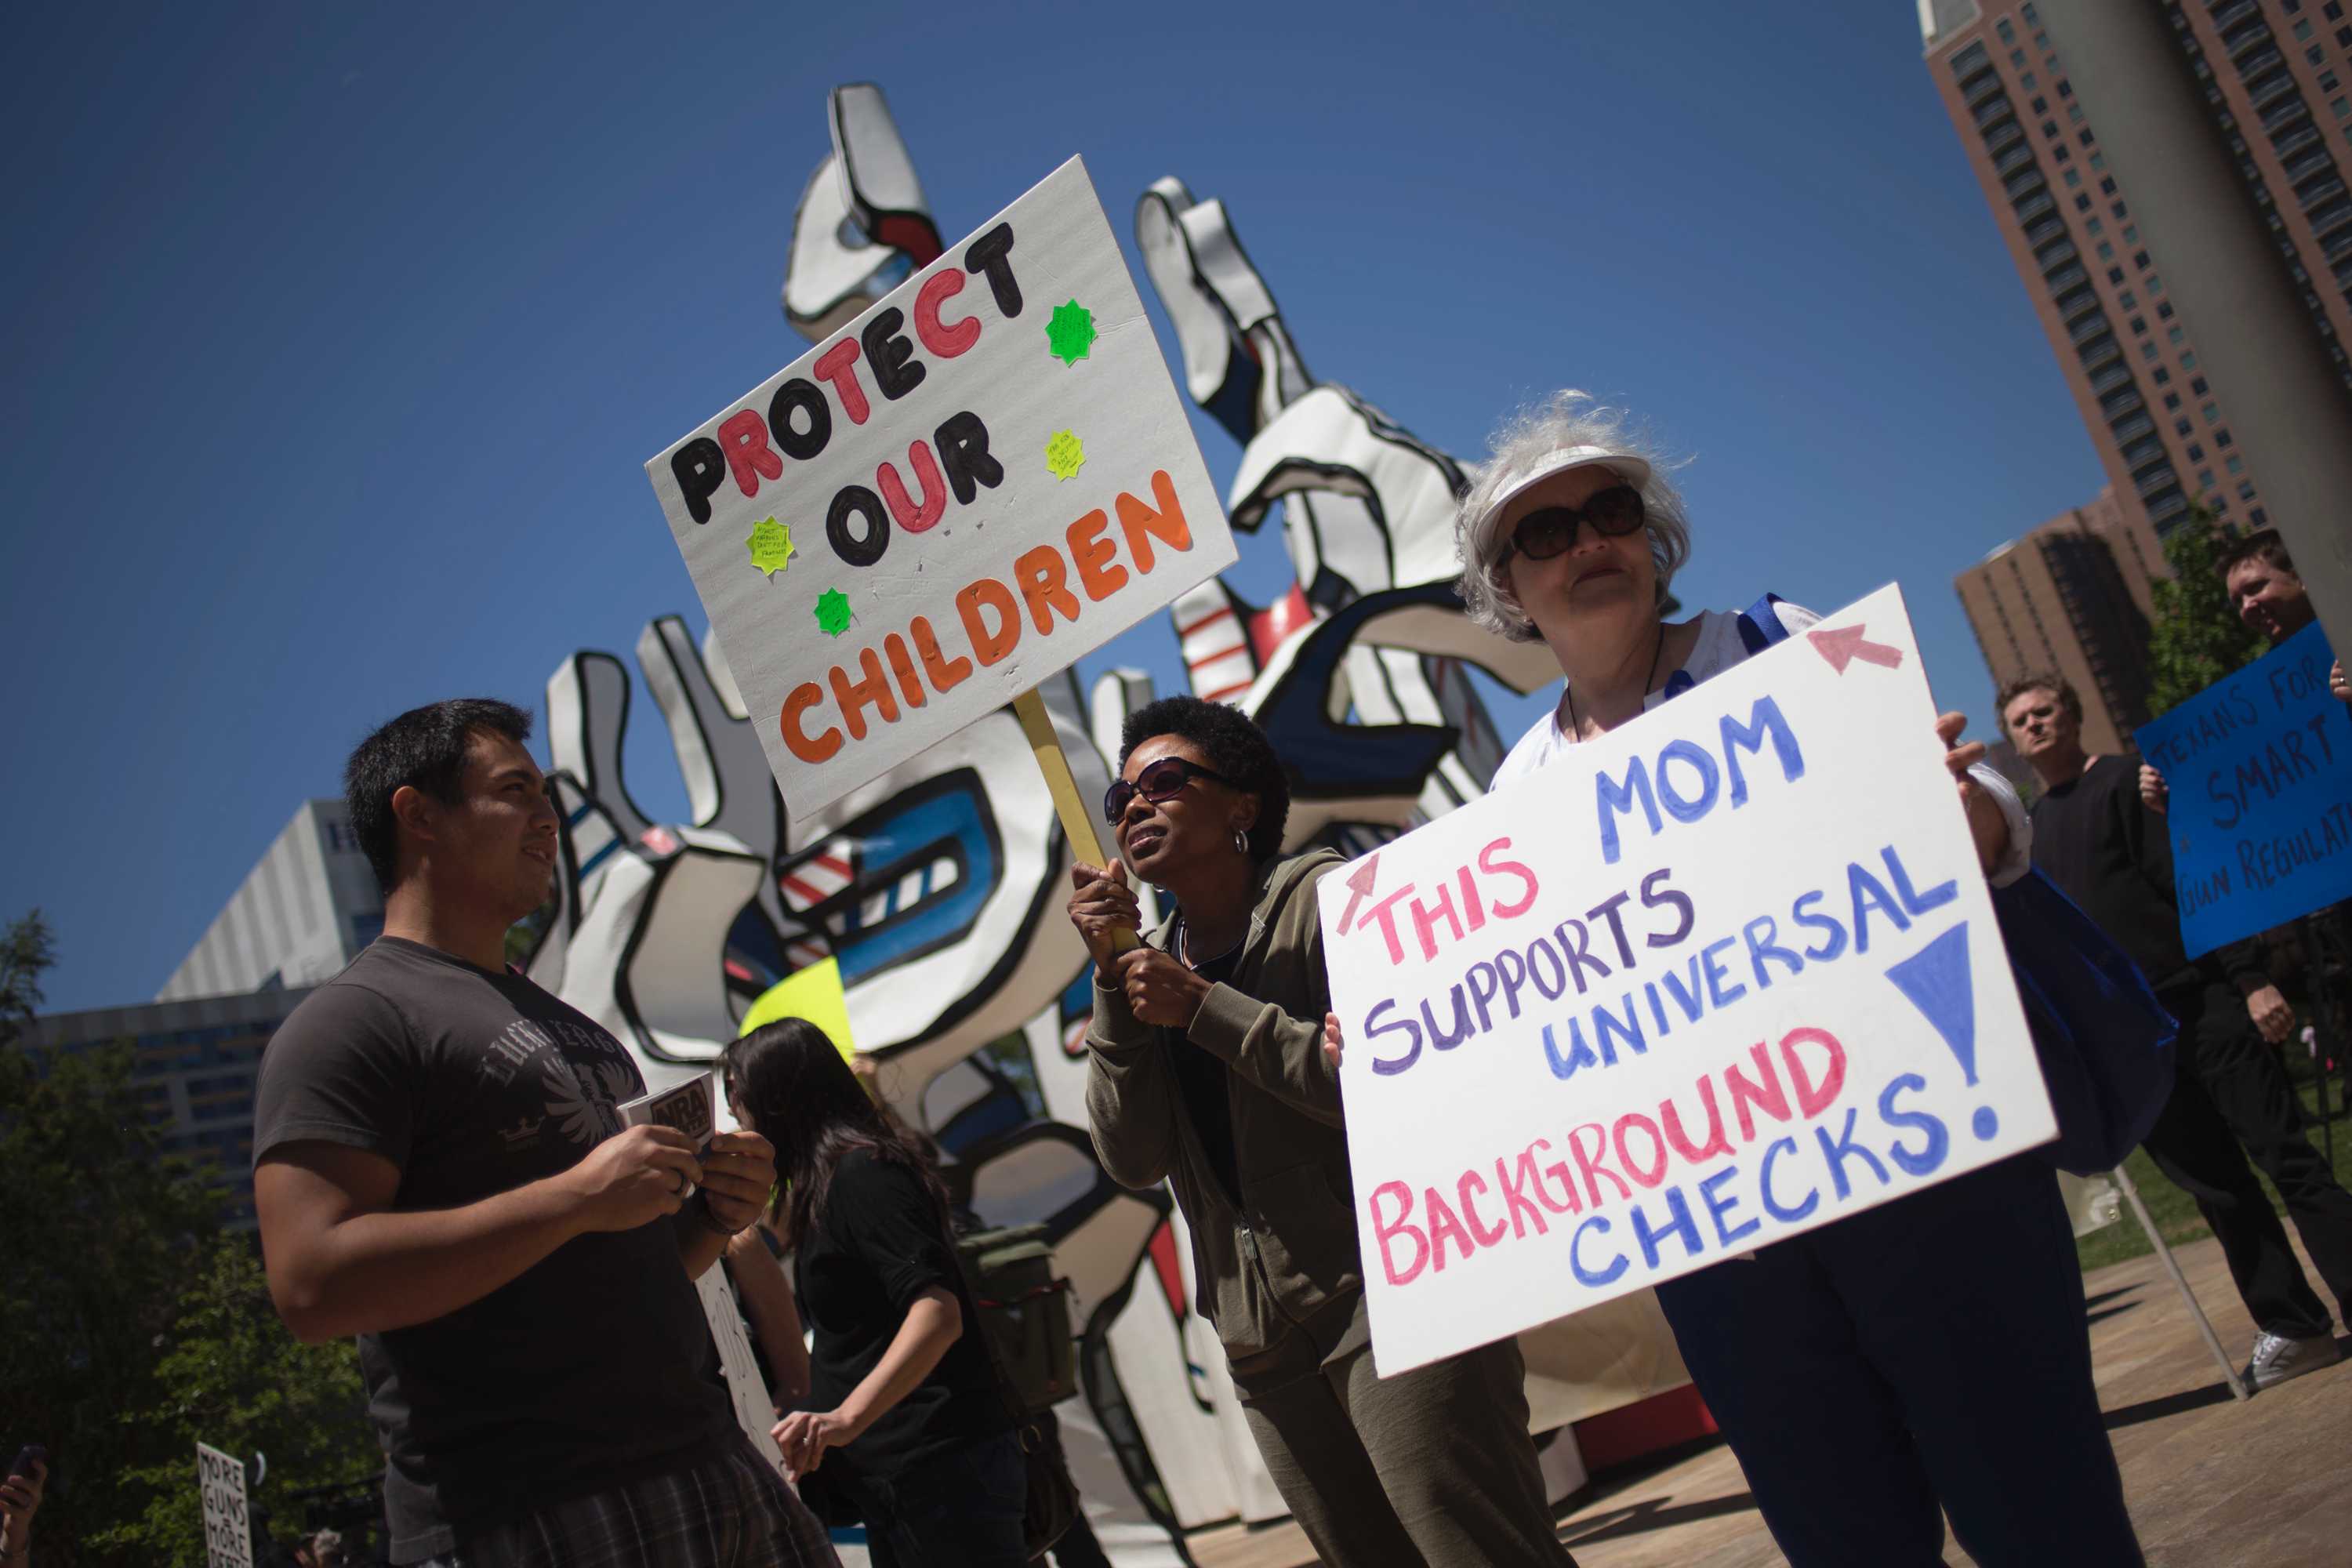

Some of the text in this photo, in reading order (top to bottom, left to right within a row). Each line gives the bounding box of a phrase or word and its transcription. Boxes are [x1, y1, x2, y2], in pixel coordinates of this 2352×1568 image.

[671, 222, 1024, 524] PROTECT
[826, 411, 1004, 567] OUR
[780, 470, 1190, 764] CHILDREN
[2149, 654, 2328, 772] TEXANS FOR
[2207, 714, 2334, 830] SMART
[1358, 695, 1805, 965] THIS MOM
[2179, 865, 2231, 916] GUN
[1364, 867, 1695, 1076] SUPPORTS
[1542, 844, 1959, 1080] UNIVERSAL
[653, 1089, 706, 1126] NRA
[1369, 1027, 1847, 1287] BACKGROUND
[200, 1451, 243, 1493] MORE
[204, 1484, 245, 1526] GUNS
[208, 1520, 249, 1562] MORE
